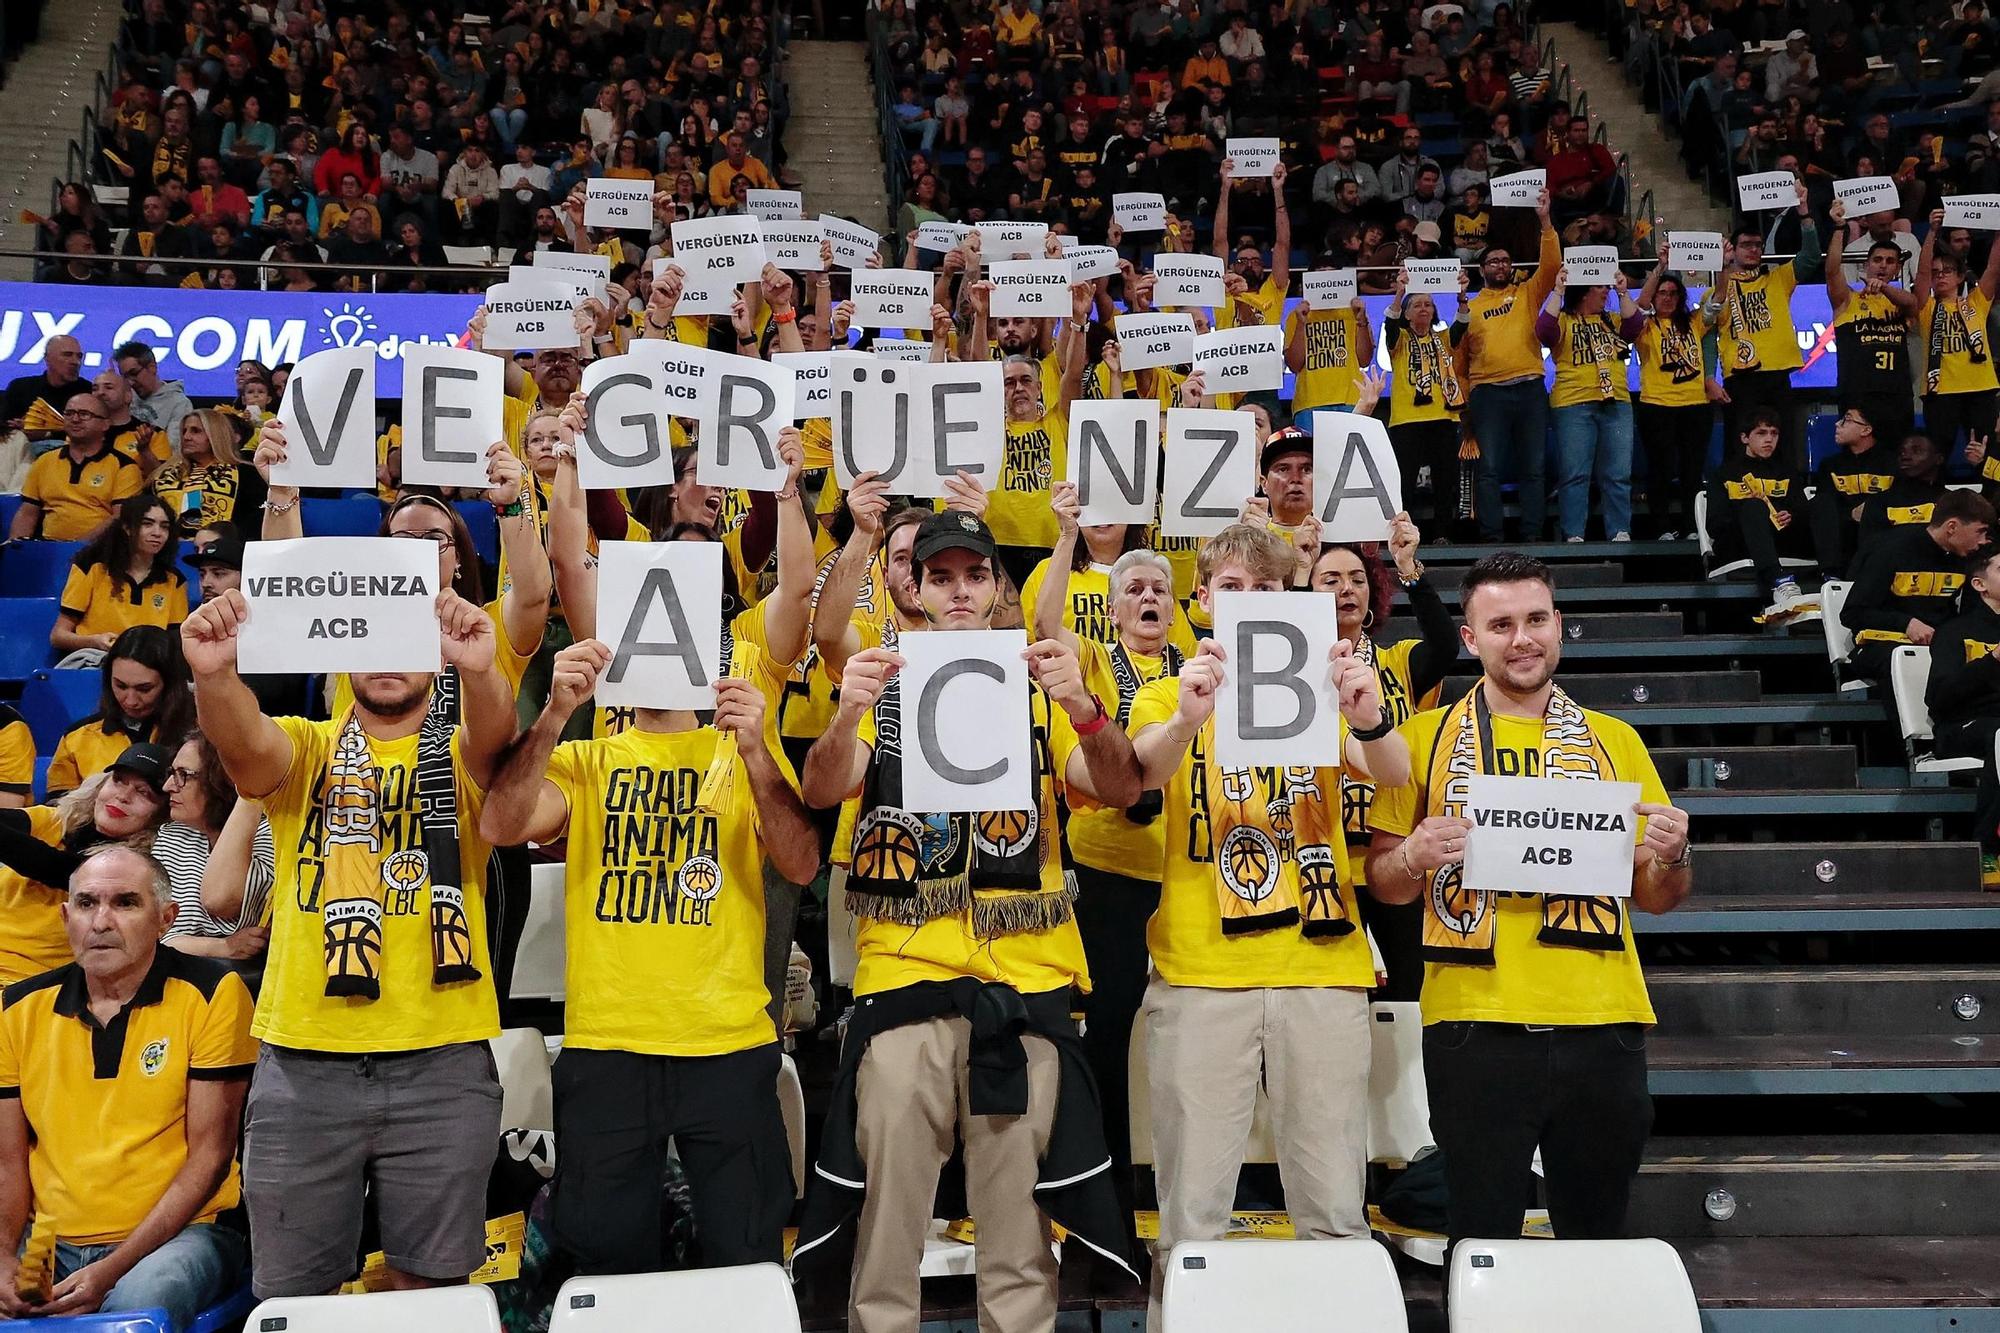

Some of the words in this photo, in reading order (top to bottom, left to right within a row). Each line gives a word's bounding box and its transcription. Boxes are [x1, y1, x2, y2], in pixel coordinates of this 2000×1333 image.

[1229, 148, 1276, 156] VERGÜENZA
[1493, 178, 1543, 188] VERGÜENZA
[1742, 179, 1794, 192] VERGÜENZA
[589, 190, 649, 201] VERGÜENZA
[1510, 190, 1527, 198] ACB
[1837, 182, 1891, 198] VERGÜENZA
[1760, 192, 1778, 200] ACB
[1858, 196, 1876, 206] ACB
[749, 199, 798, 209] VERGÜENZA
[1115, 202, 1162, 212] VERGÜENZA
[1946, 200, 1999, 209] VERGÜENZA
[607, 207, 628, 216] ACB
[765, 213, 782, 221] ACB
[1963, 212, 1981, 220] ACB
[1132, 214, 1148, 222] ACB
[676, 232, 759, 251] VERGÜENZA
[763, 232, 820, 243] ERGÜENZA
[1000, 232, 1022, 240] ACB
[1671, 240, 1720, 250] VERGÜENZA
[777, 250, 798, 258] ACB
[835, 246, 855, 257] ACB
[1687, 253, 1704, 261] ACB
[706, 256, 735, 269] ACB
[1077, 260, 1096, 270] ACB
[1566, 255, 1616, 265] VERGÜENZA
[1156, 267, 1221, 279] VERGÜENZA
[1407, 264, 1458, 273] VERGÜENZA
[1582, 268, 1600, 276] ACB
[992, 273, 1067, 285] VERGÜENZA
[1304, 279, 1353, 290] VERGÜENZA
[854, 284, 929, 297] VERGÜENZA
[1178, 284, 1200, 294] ACB
[683, 291, 708, 301] ACB
[1017, 292, 1042, 303] ACB
[1321, 292, 1338, 301] ACB
[486, 298, 573, 314] VERGÜENZA
[878, 303, 904, 314] ACB
[515, 321, 545, 333] ACB
[1120, 323, 1192, 340] VERGÜENZA
[1306, 320, 1346, 338] GRADA
[1146, 342, 1171, 354] ACB
[1307, 335, 1345, 354] ANIMA
[1195, 340, 1276, 362] VERGÜENZA
[1875, 351, 1894, 371] 31
[1221, 365, 1249, 377] ACB
[664, 384, 697, 400] ACB
[807, 388, 831, 401] AC
[293, 368, 364, 466] V
[423, 366, 478, 463] E
[584, 373, 660, 468] G
[717, 374, 776, 470] R
[841, 367, 908, 482] Ü
[932, 382, 985, 476] E
[1079, 419, 1146, 506] N
[1180, 429, 1239, 518] Z
[1321, 432, 1396, 522] A
[248, 570, 428, 598] VERGÜENZA
[307, 617, 369, 639] ACB
[605, 568, 708, 687] A
[917, 658, 1009, 785] C
[1237, 620, 1317, 741] B
[605, 767, 709, 815] GRAD
[1473, 807, 1627, 832] VERGÜENZA
[602, 815, 719, 867] ANIMA
[1521, 846, 1573, 865] ACB
[1479, 1257, 1485, 1266] 5
